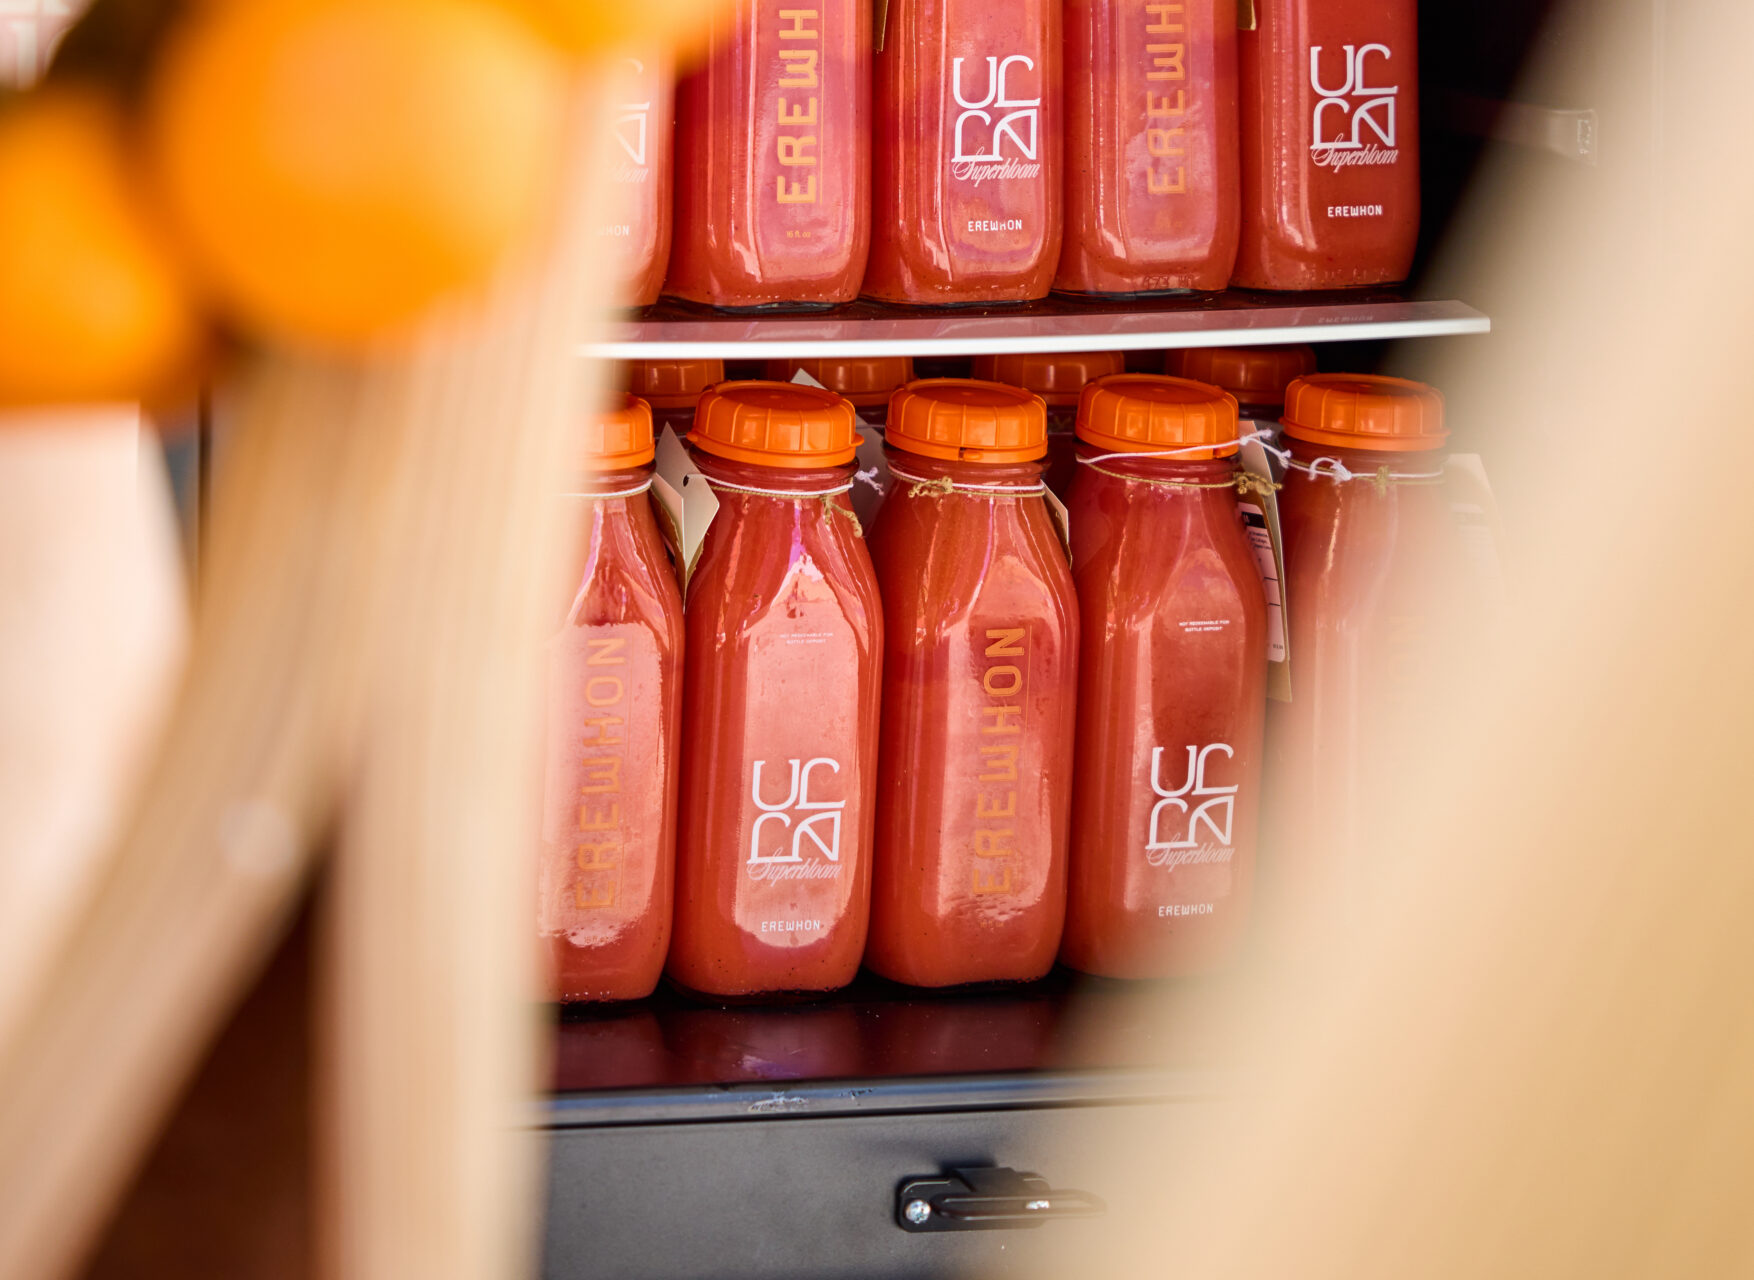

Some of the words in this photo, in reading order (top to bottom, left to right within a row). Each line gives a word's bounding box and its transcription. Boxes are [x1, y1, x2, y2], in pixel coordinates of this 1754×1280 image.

[952, 146, 1041, 188] Superbloom
[1311, 132, 1399, 174] Superbloom
[967, 219, 1023, 232] EREWHON
[1327, 205, 1383, 218] EREWHON
[576, 637, 627, 910] EREWHON
[973, 628, 1026, 894] EREWHON
[747, 846, 843, 887] Superbloom
[1146, 832, 1236, 873] Superbloom
[761, 919, 821, 932] EREWHON
[1158, 903, 1214, 918] EREWHON
